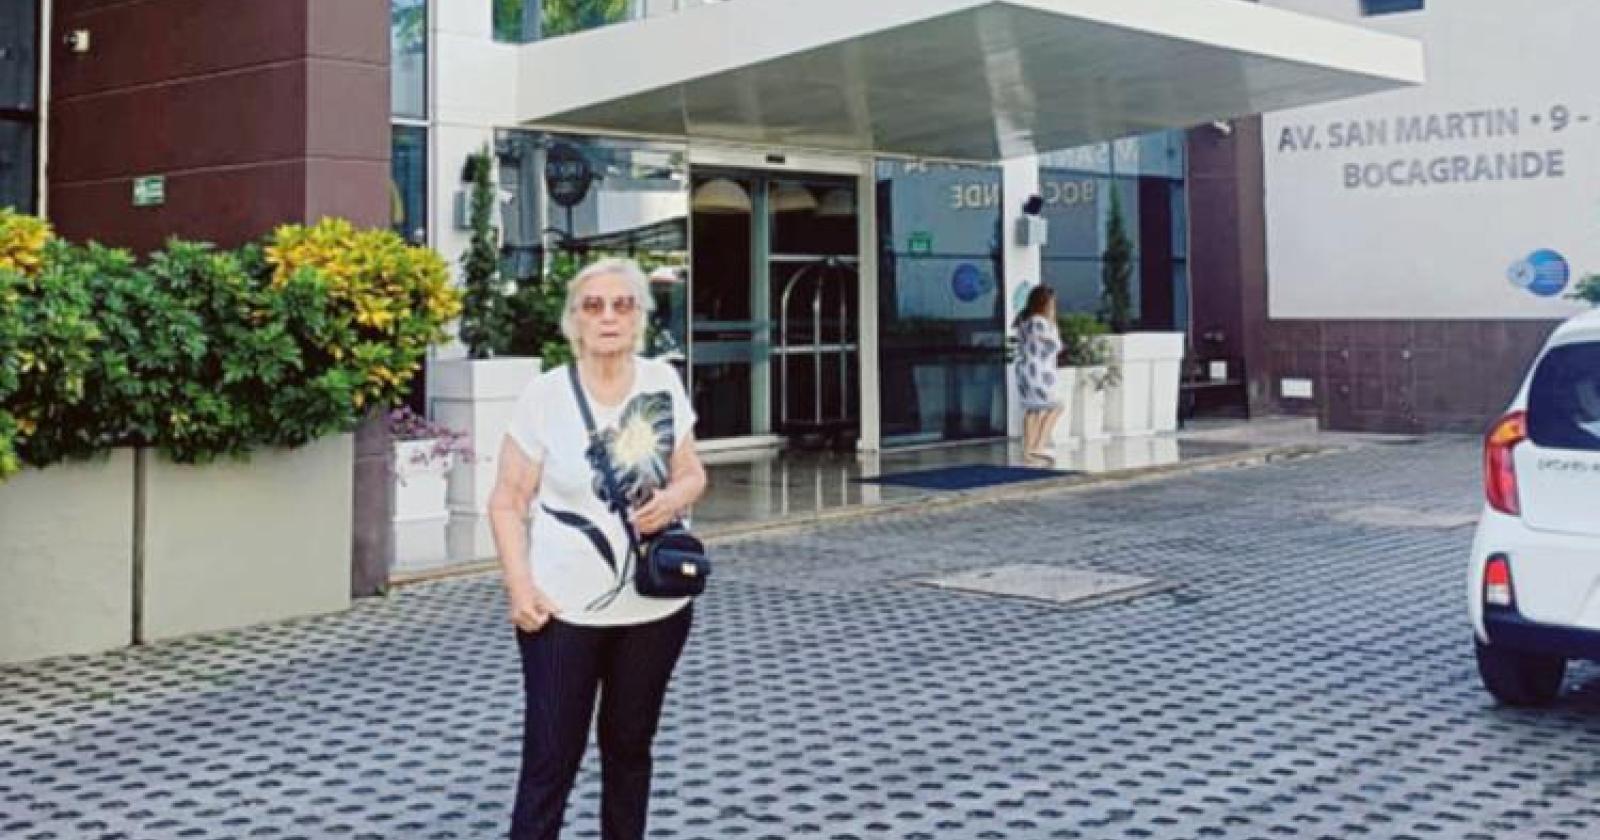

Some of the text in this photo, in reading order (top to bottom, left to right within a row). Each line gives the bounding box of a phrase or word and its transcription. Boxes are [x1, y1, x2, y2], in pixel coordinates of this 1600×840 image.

[1278, 124, 1321, 151] AV.
[1328, 119, 1387, 147] SAN
[1396, 107, 1519, 144] MARTIN
[1549, 104, 1568, 132] 9
[1343, 150, 1565, 188] BOCAGRANDE
